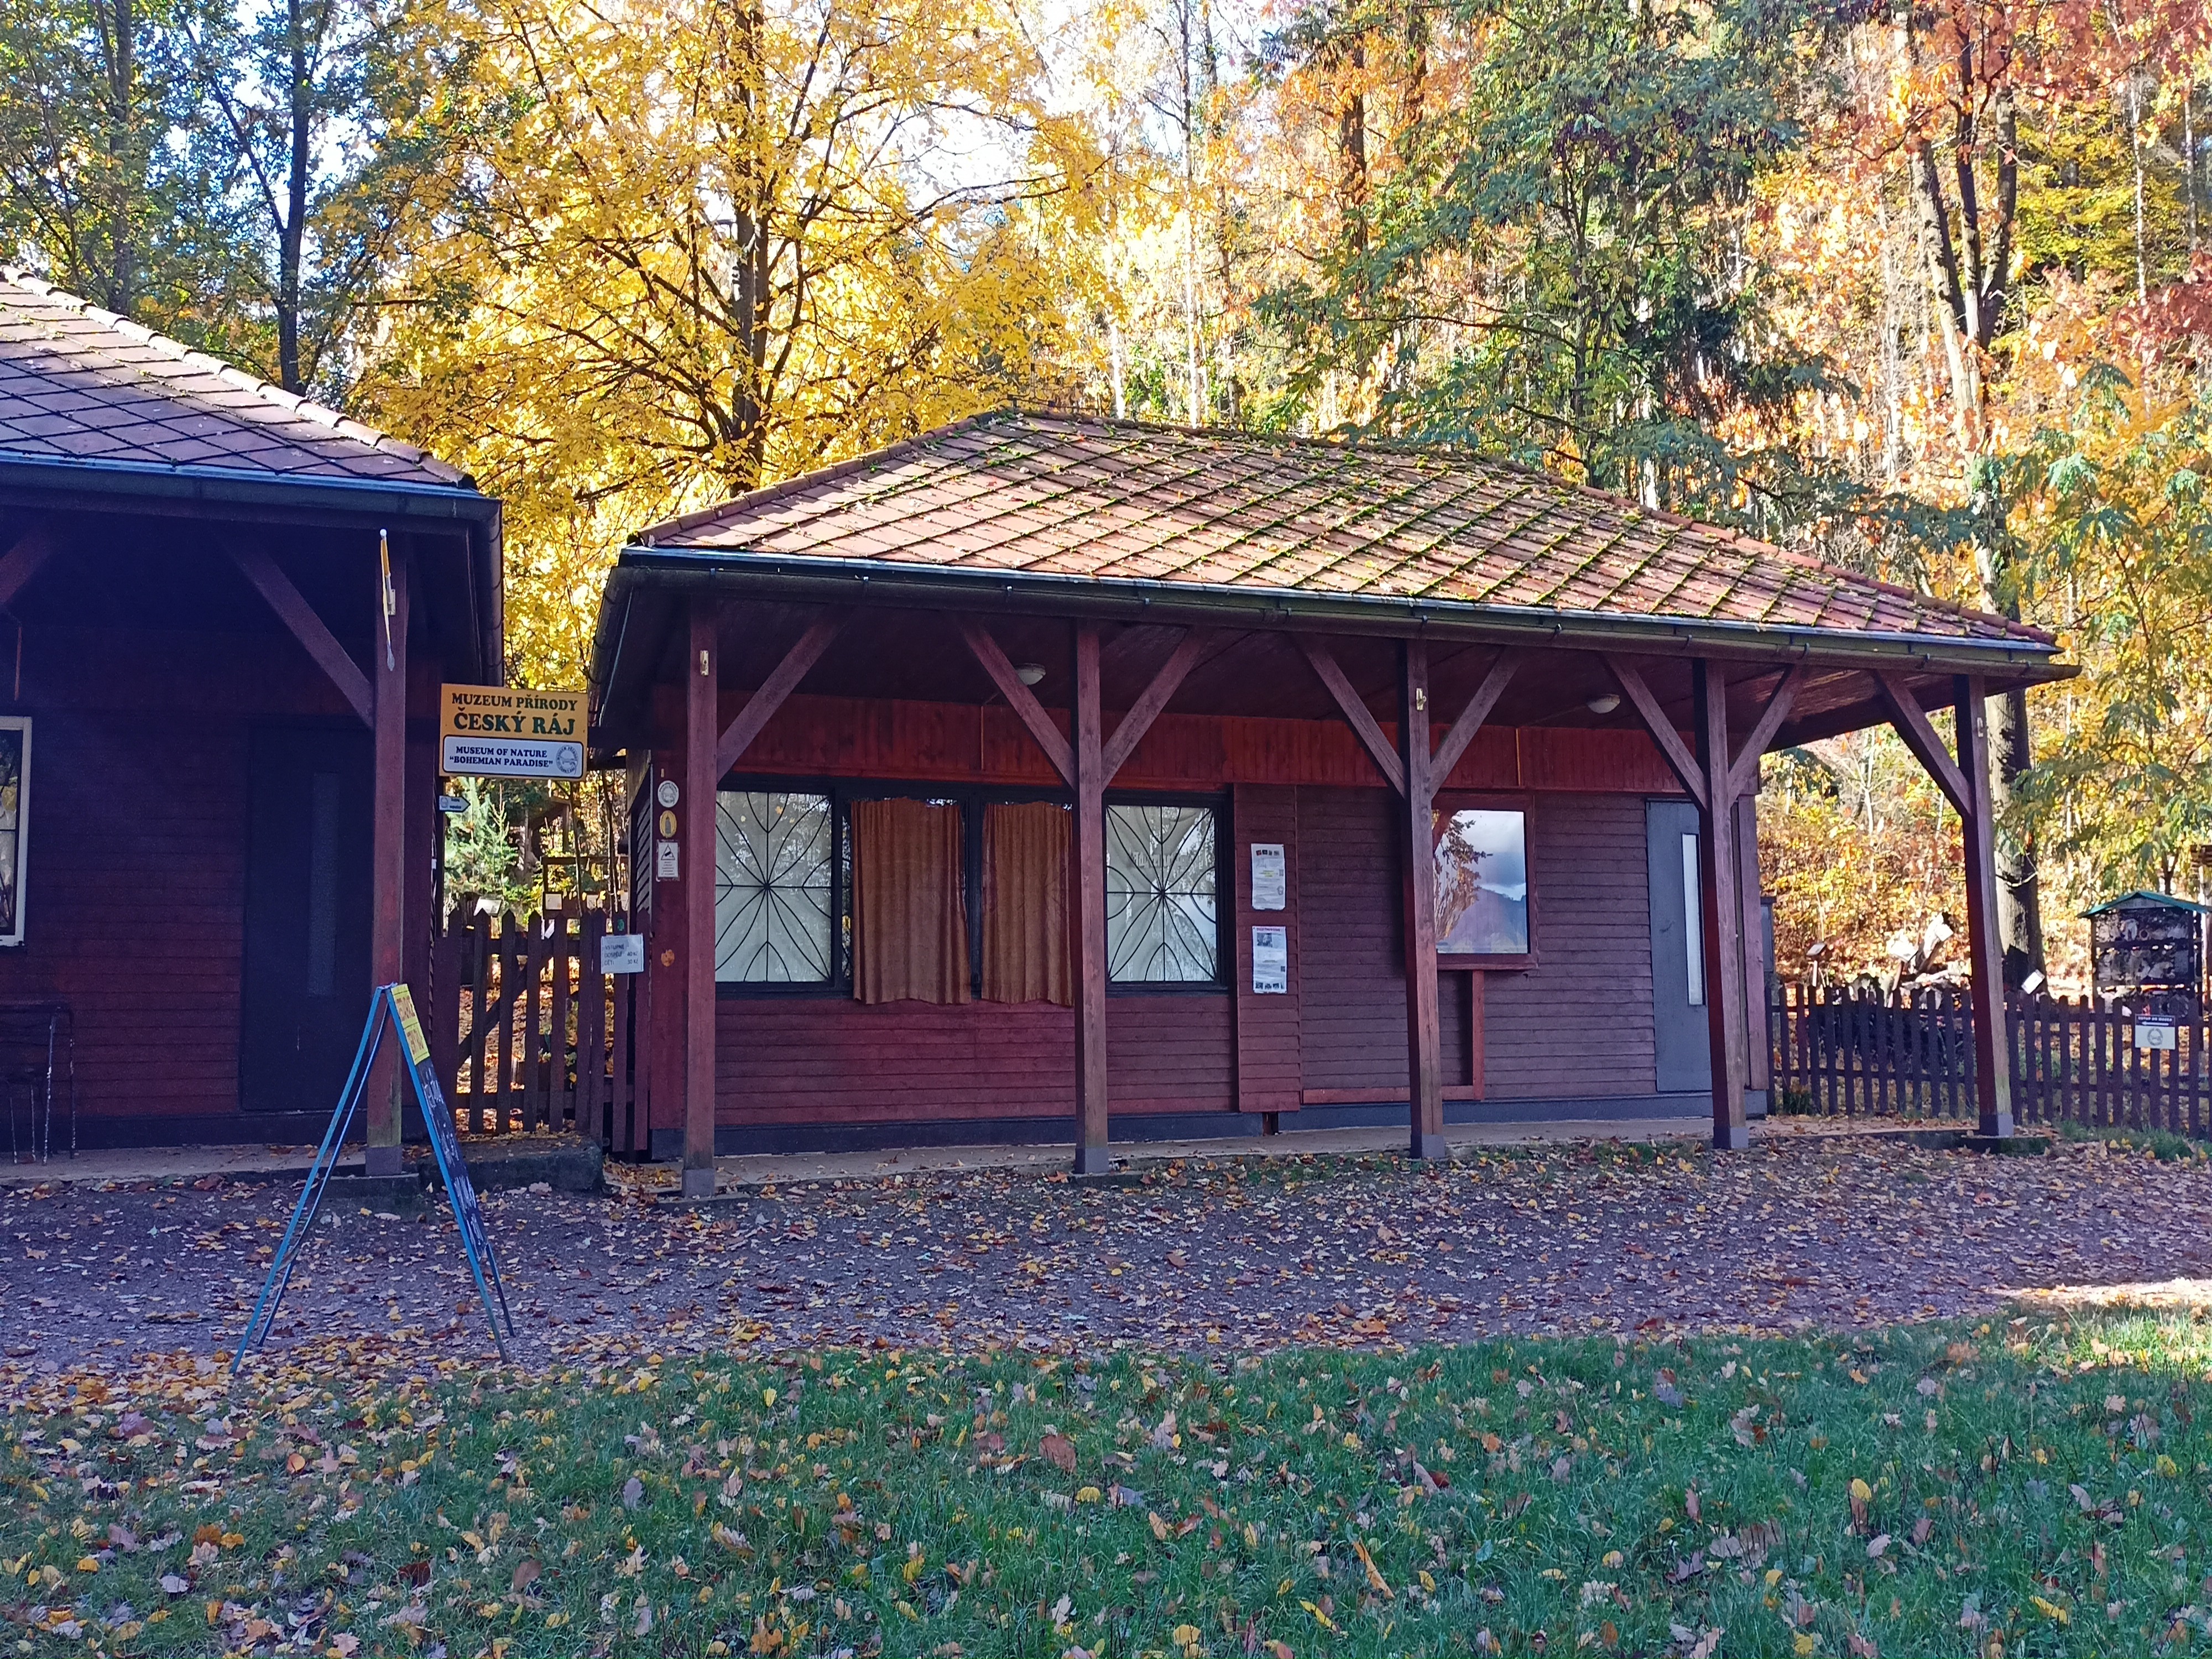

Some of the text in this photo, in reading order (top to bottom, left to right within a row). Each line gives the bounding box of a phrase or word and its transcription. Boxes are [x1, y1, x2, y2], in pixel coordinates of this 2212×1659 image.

[452, 692, 578, 711] MUZEUM PŘÍRODY
[453, 706, 576, 735] ČESKÝ RÁJ
[456, 746, 494, 755] MUSEUM
[510, 749, 547, 758] NATURE
